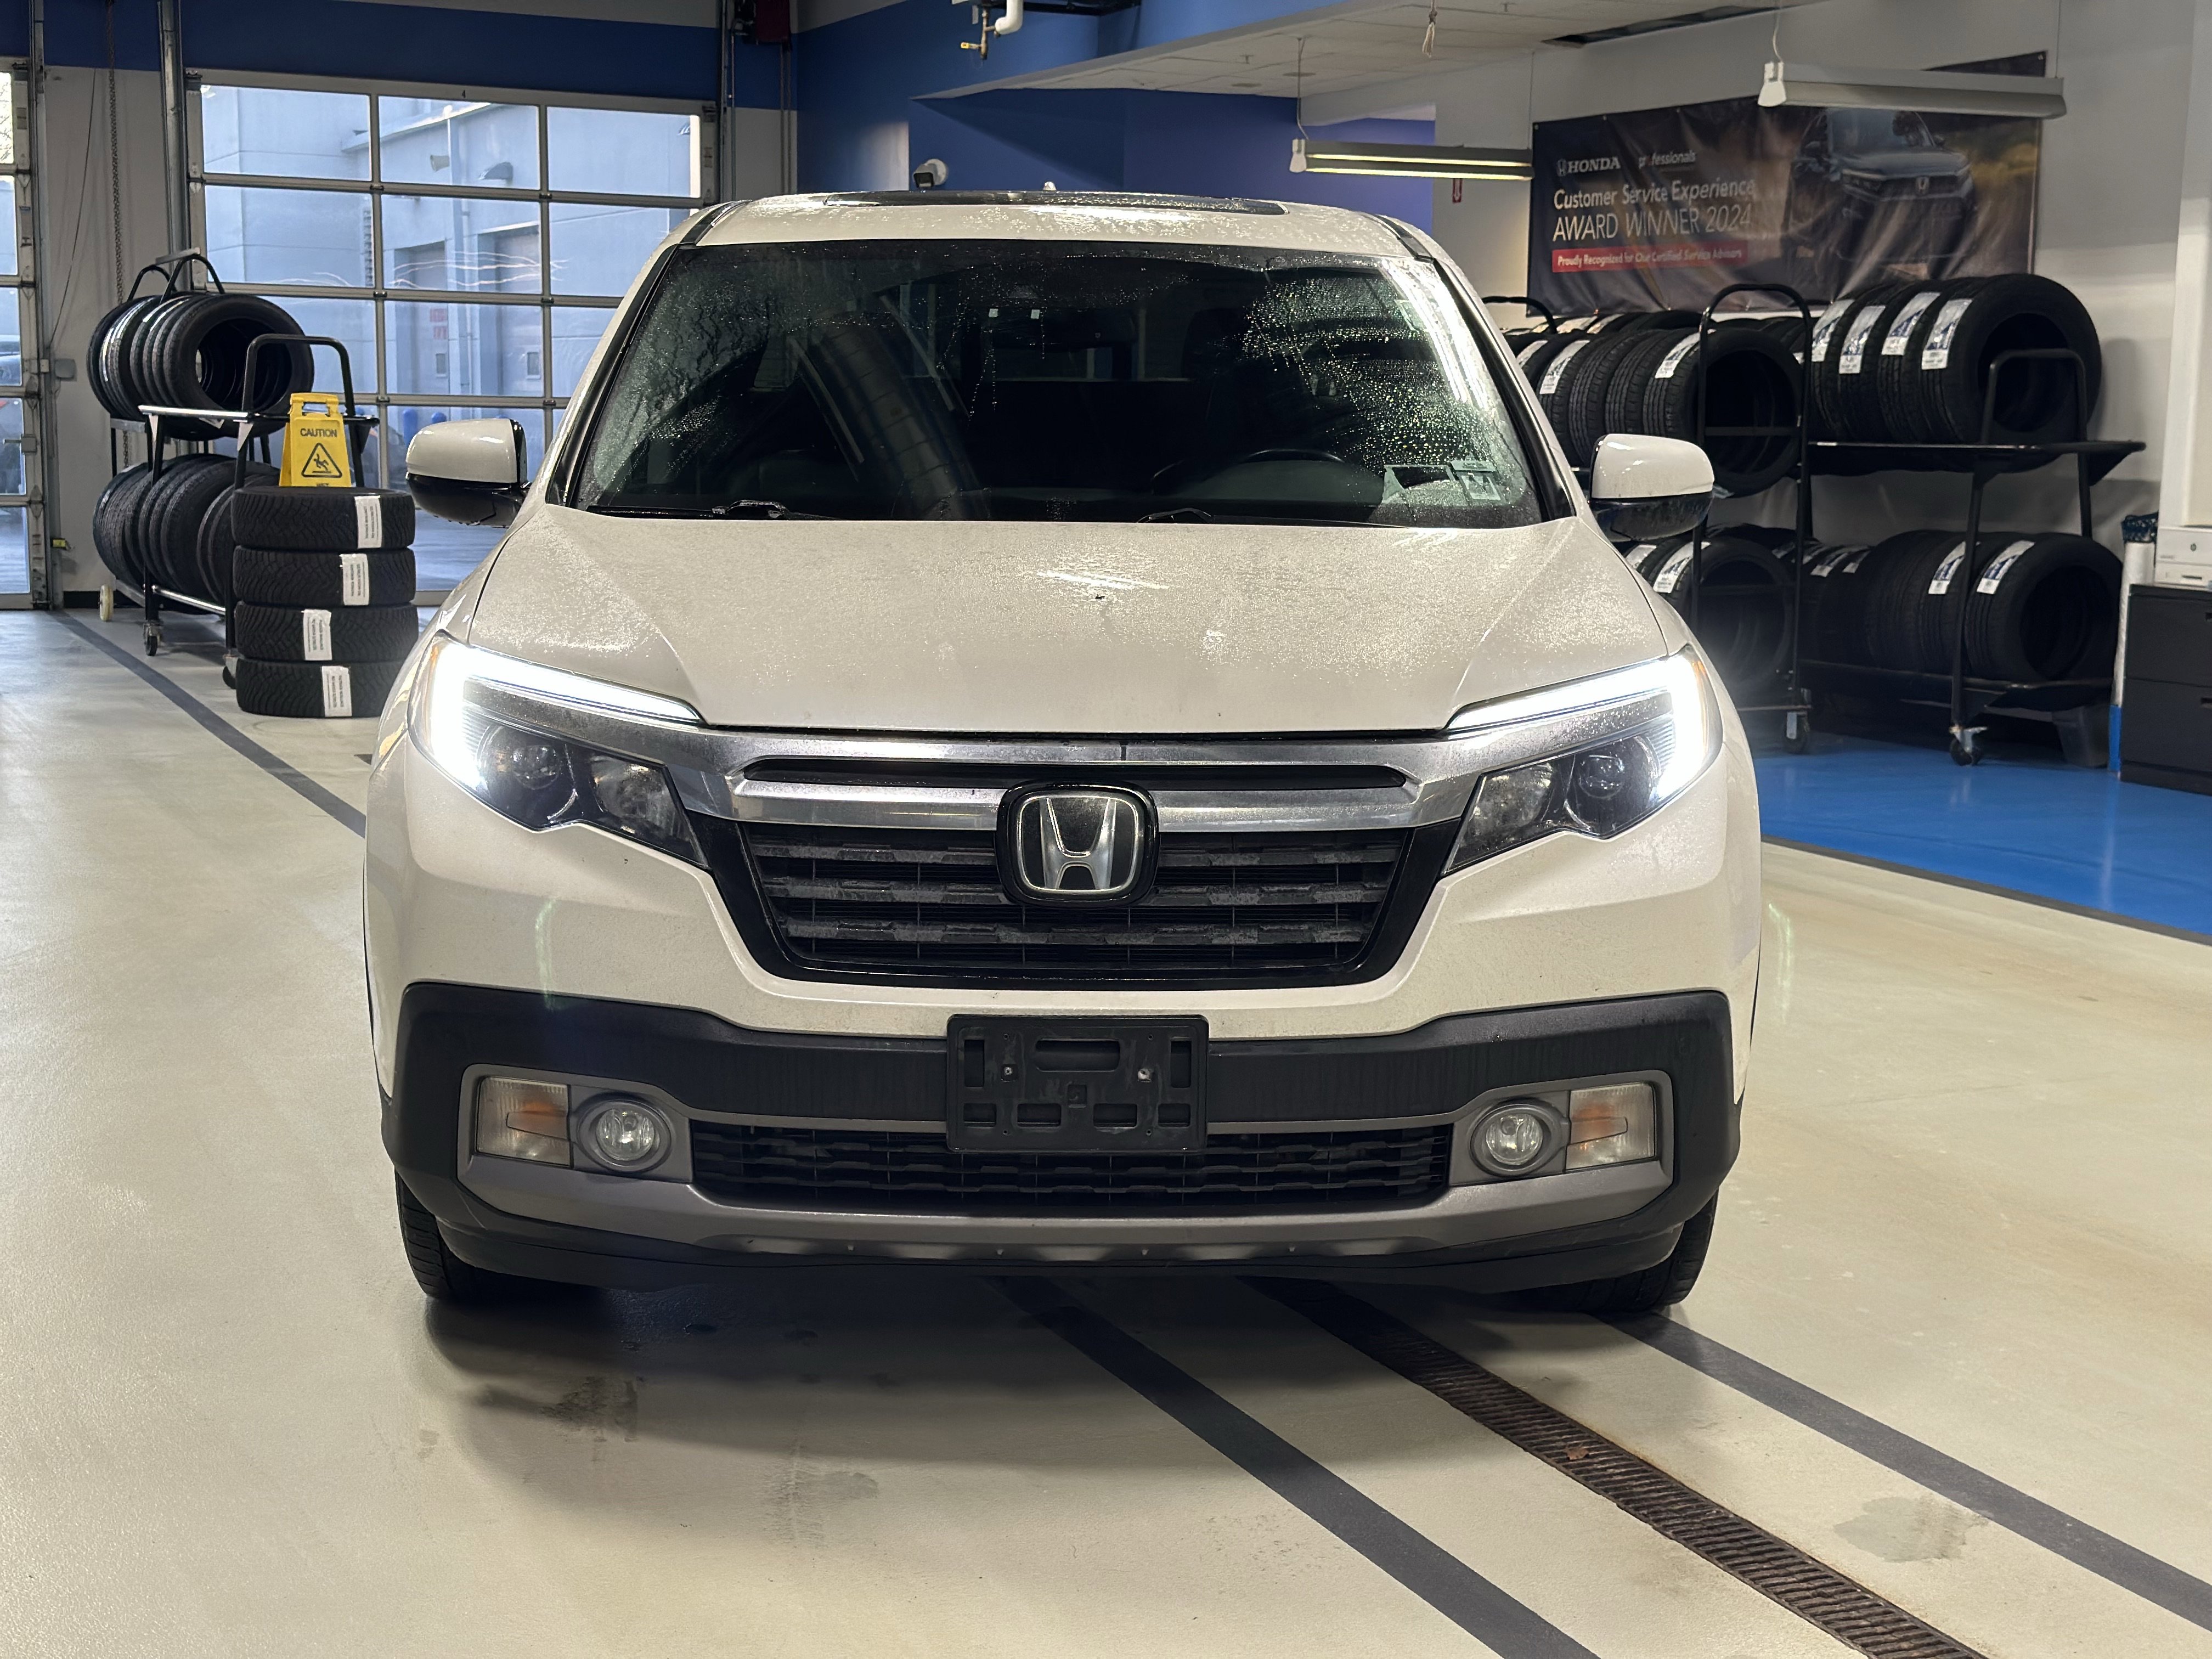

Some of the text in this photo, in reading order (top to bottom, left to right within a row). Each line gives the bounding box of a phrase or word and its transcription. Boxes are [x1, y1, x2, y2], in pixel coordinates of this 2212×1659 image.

[1567, 156, 1621, 173] HONDA
[1554, 177, 1756, 210] Customer Service Experience
[1553, 203, 1752, 242] AWARD WINNER 2024
[1558, 255, 1582, 268] Proudly
[1584, 253, 1623, 267] Recognized
[1624, 252, 1634, 263] for
[300, 428, 337, 437] CAUTION
